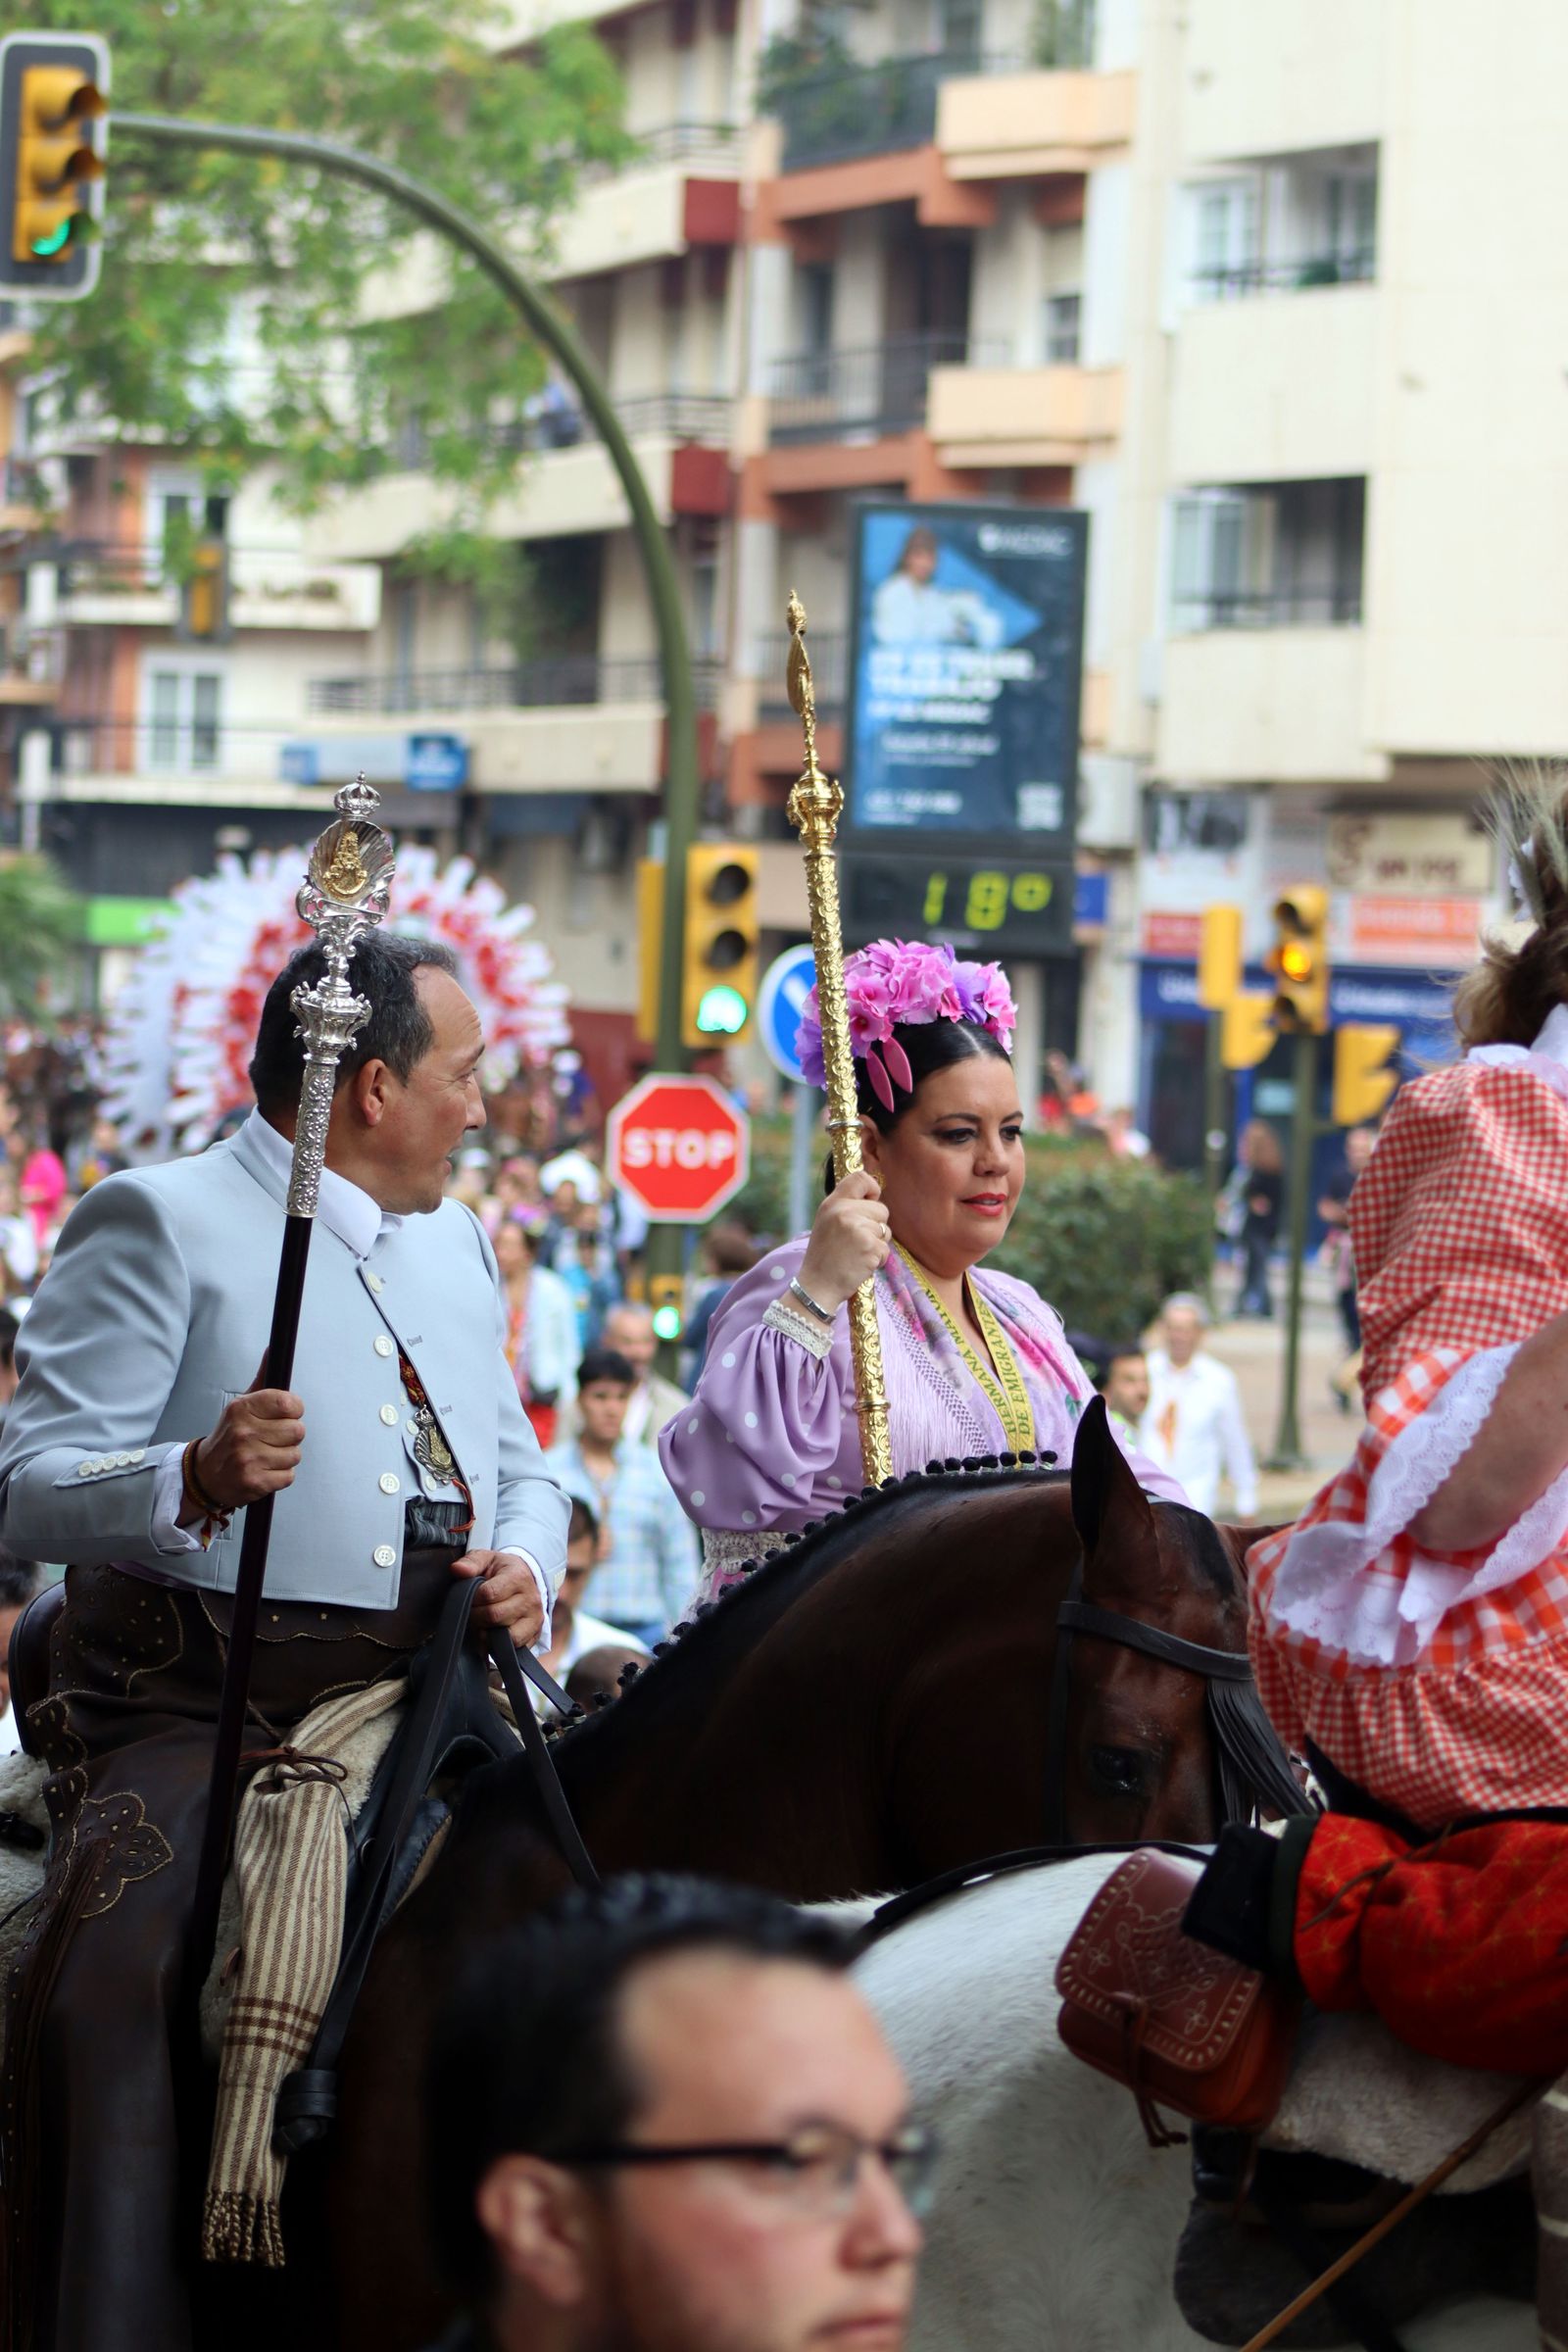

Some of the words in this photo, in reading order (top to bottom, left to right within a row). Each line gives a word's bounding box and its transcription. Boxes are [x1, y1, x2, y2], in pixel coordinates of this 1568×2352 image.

[623, 1127, 736, 1170] STOP
[962, 1348, 1017, 1434] HERMANA
[1015, 1410, 1031, 1436] DE
